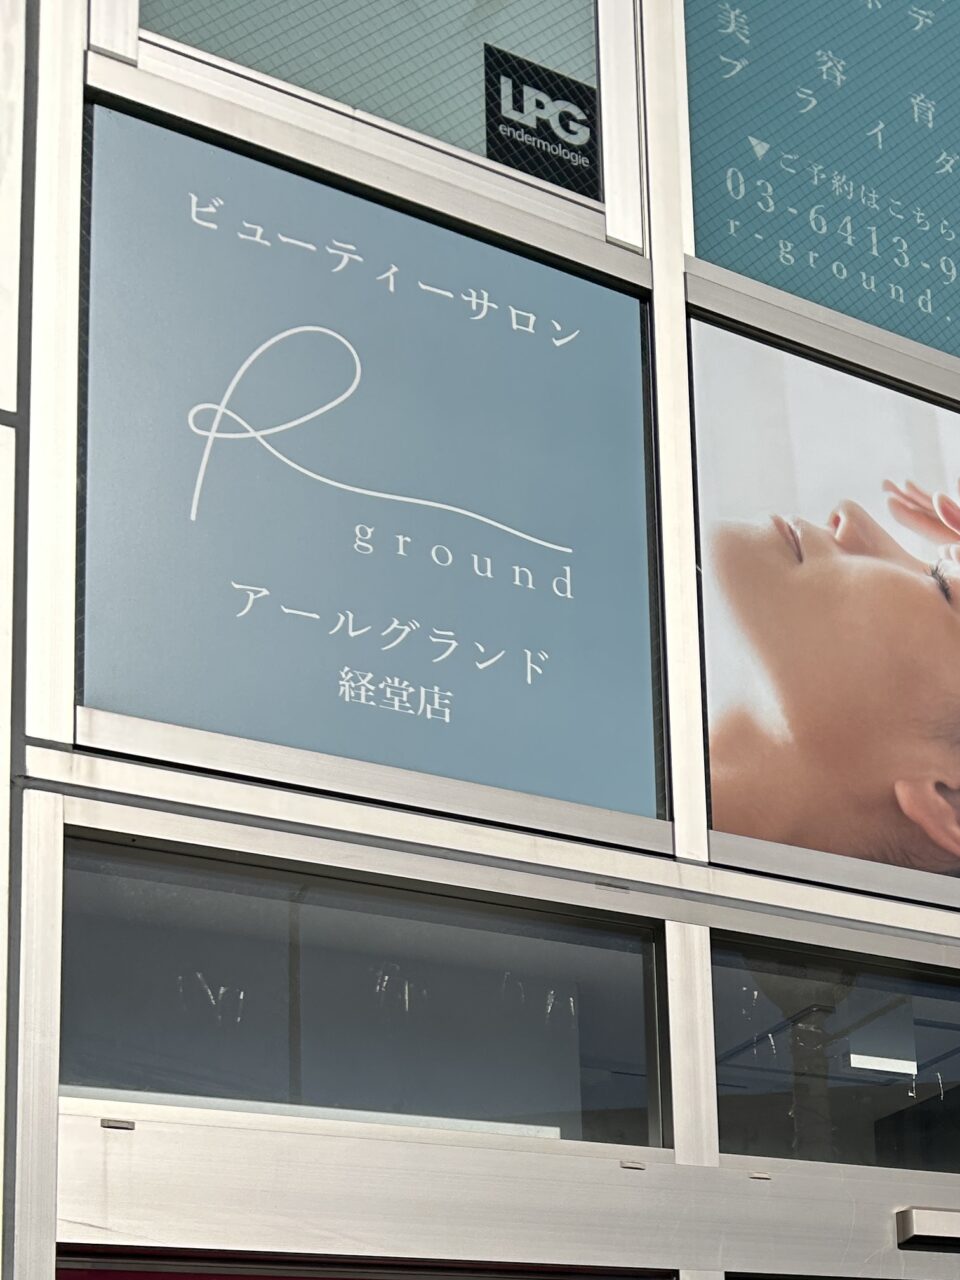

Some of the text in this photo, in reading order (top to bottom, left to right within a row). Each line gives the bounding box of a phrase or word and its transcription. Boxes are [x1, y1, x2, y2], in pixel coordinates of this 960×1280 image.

[498, 123, 590, 167] endermologie
[500, 74, 591, 146] LPG
[188, 192, 580, 347] ビューティーサロン
[353, 522, 574, 599] ground
[231, 580, 549, 685] アールグランド
[337, 665, 453, 723] 経堂店
